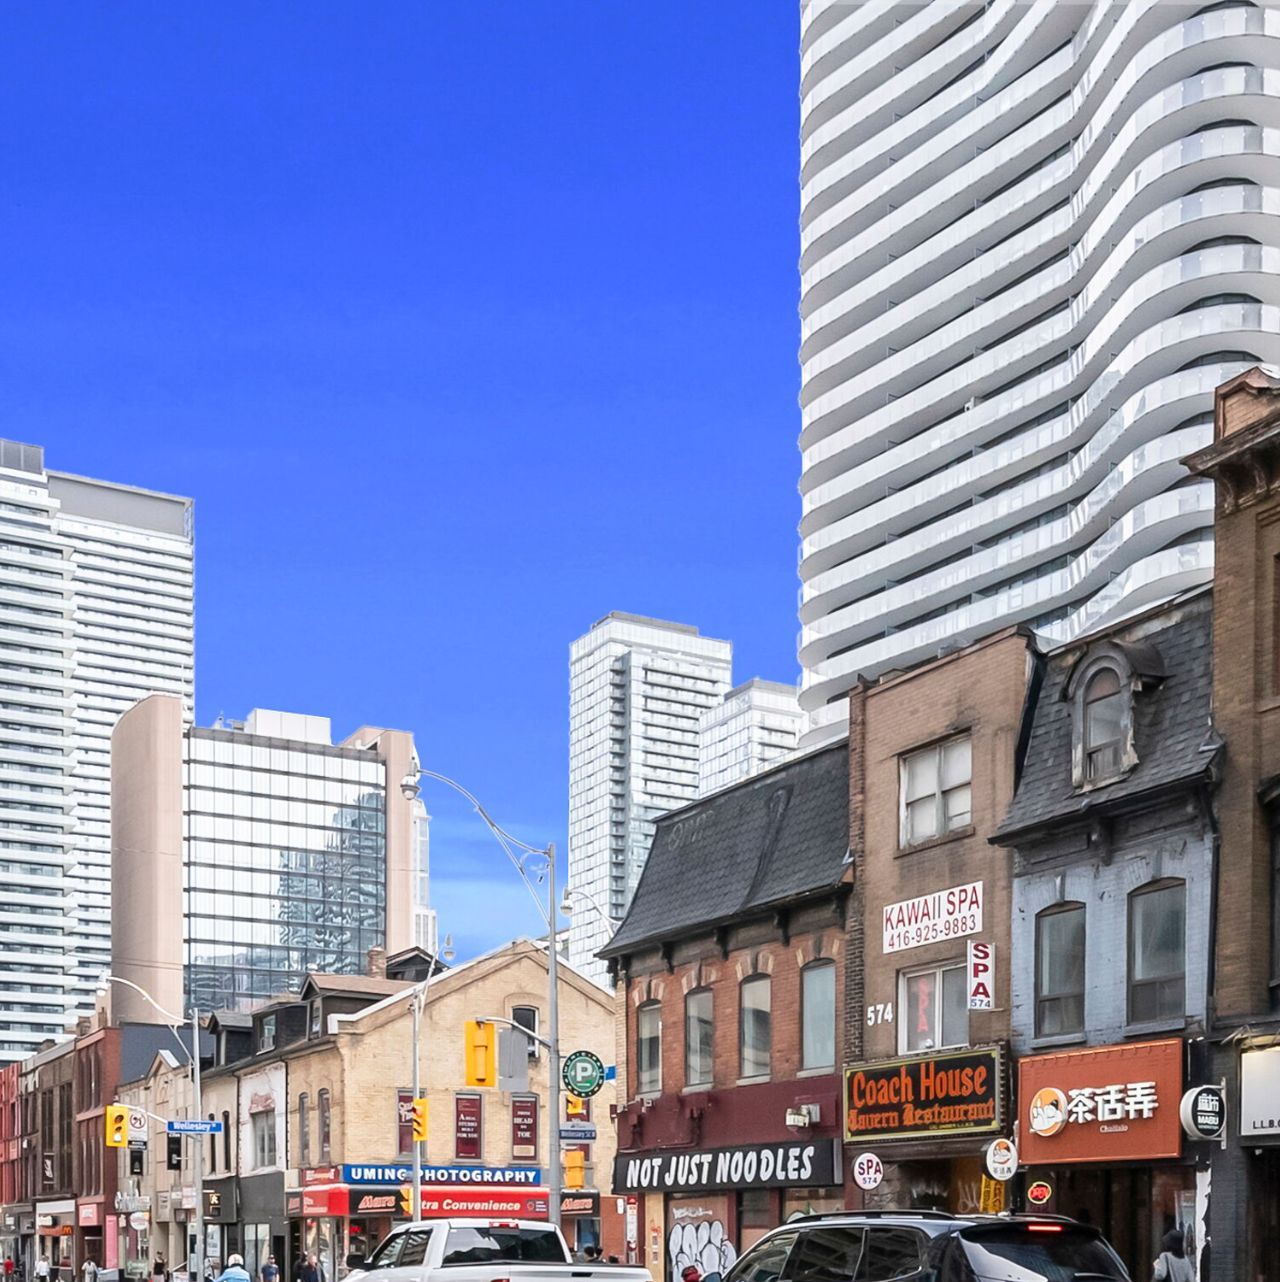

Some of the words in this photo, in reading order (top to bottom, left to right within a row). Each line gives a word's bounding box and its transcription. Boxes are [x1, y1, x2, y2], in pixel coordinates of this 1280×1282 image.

[885, 895, 941, 932] KAWAII
[946, 886, 980, 916] SPA
[888, 914, 976, 949] 416-925-9883
[972, 943, 990, 998] SPA
[867, 1002, 892, 1026] 574
[971, 999, 990, 1008] 574
[576, 1063, 593, 1081] P
[853, 1065, 914, 1108] Coach
[920, 1061, 987, 1100] House
[848, 1109, 899, 1131] Tavern
[903, 1098, 995, 1126] Restaurant
[627, 1157, 662, 1188] NOT
[665, 1153, 713, 1185] JUST
[716, 1146, 816, 1184] NOODLES
[858, 1159, 882, 1176] SPA
[442, 1199, 521, 1210] Convenience
